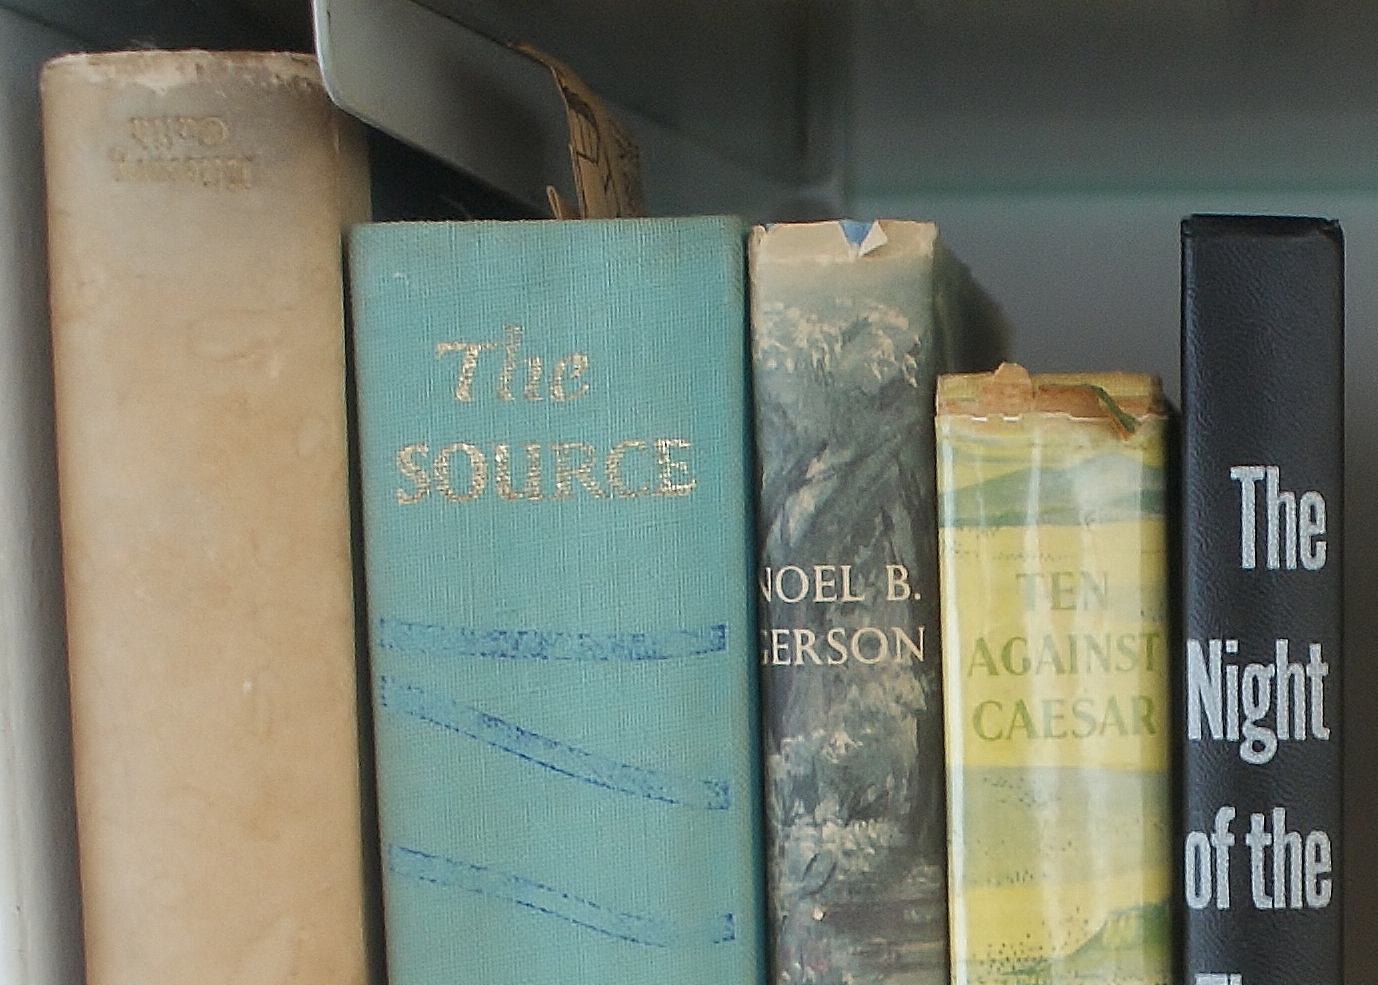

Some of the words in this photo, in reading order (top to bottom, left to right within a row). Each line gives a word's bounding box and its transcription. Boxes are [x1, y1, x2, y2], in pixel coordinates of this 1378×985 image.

[434, 323, 589, 402] The
[396, 437, 697, 504] SOURCE
[1229, 465, 1328, 571] The
[885, 564, 922, 601] B.
[1016, 570, 1110, 612] TEN
[967, 632, 1161, 678] AGAINST
[970, 695, 1157, 742] CAESAR
[1186, 638, 1332, 765] Night
[1183, 806, 1237, 910] of
[1246, 806, 1334, 910] the
